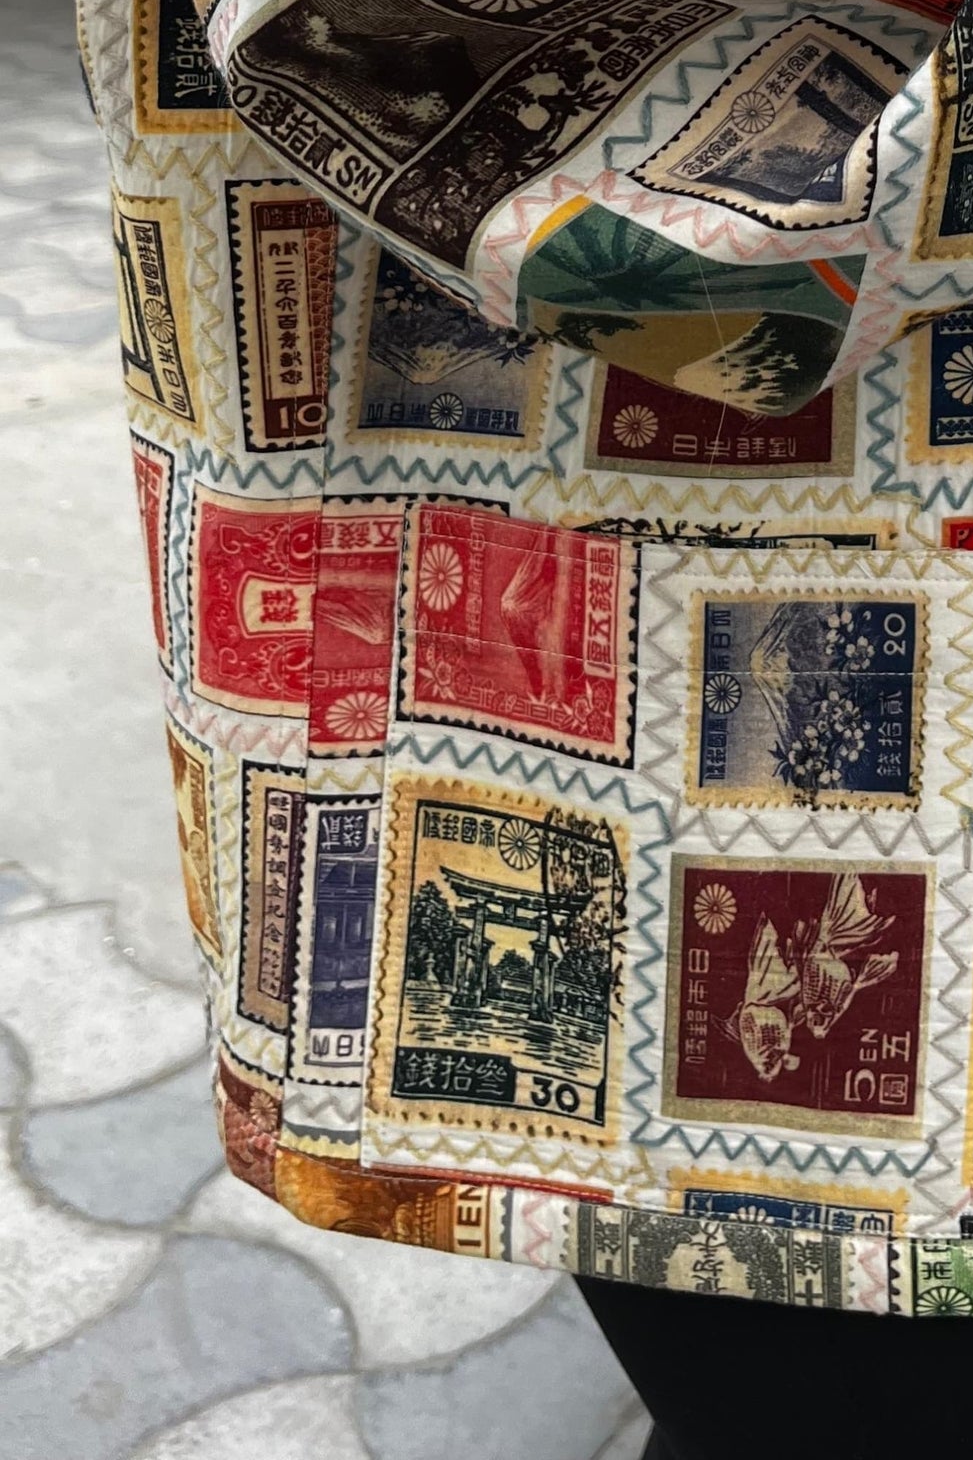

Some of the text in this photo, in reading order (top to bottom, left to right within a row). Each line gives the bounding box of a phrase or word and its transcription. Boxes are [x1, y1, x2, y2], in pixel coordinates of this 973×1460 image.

[278, 401, 327, 431] 10
[882, 612, 907, 657] 20
[529, 1073, 583, 1114] 30
